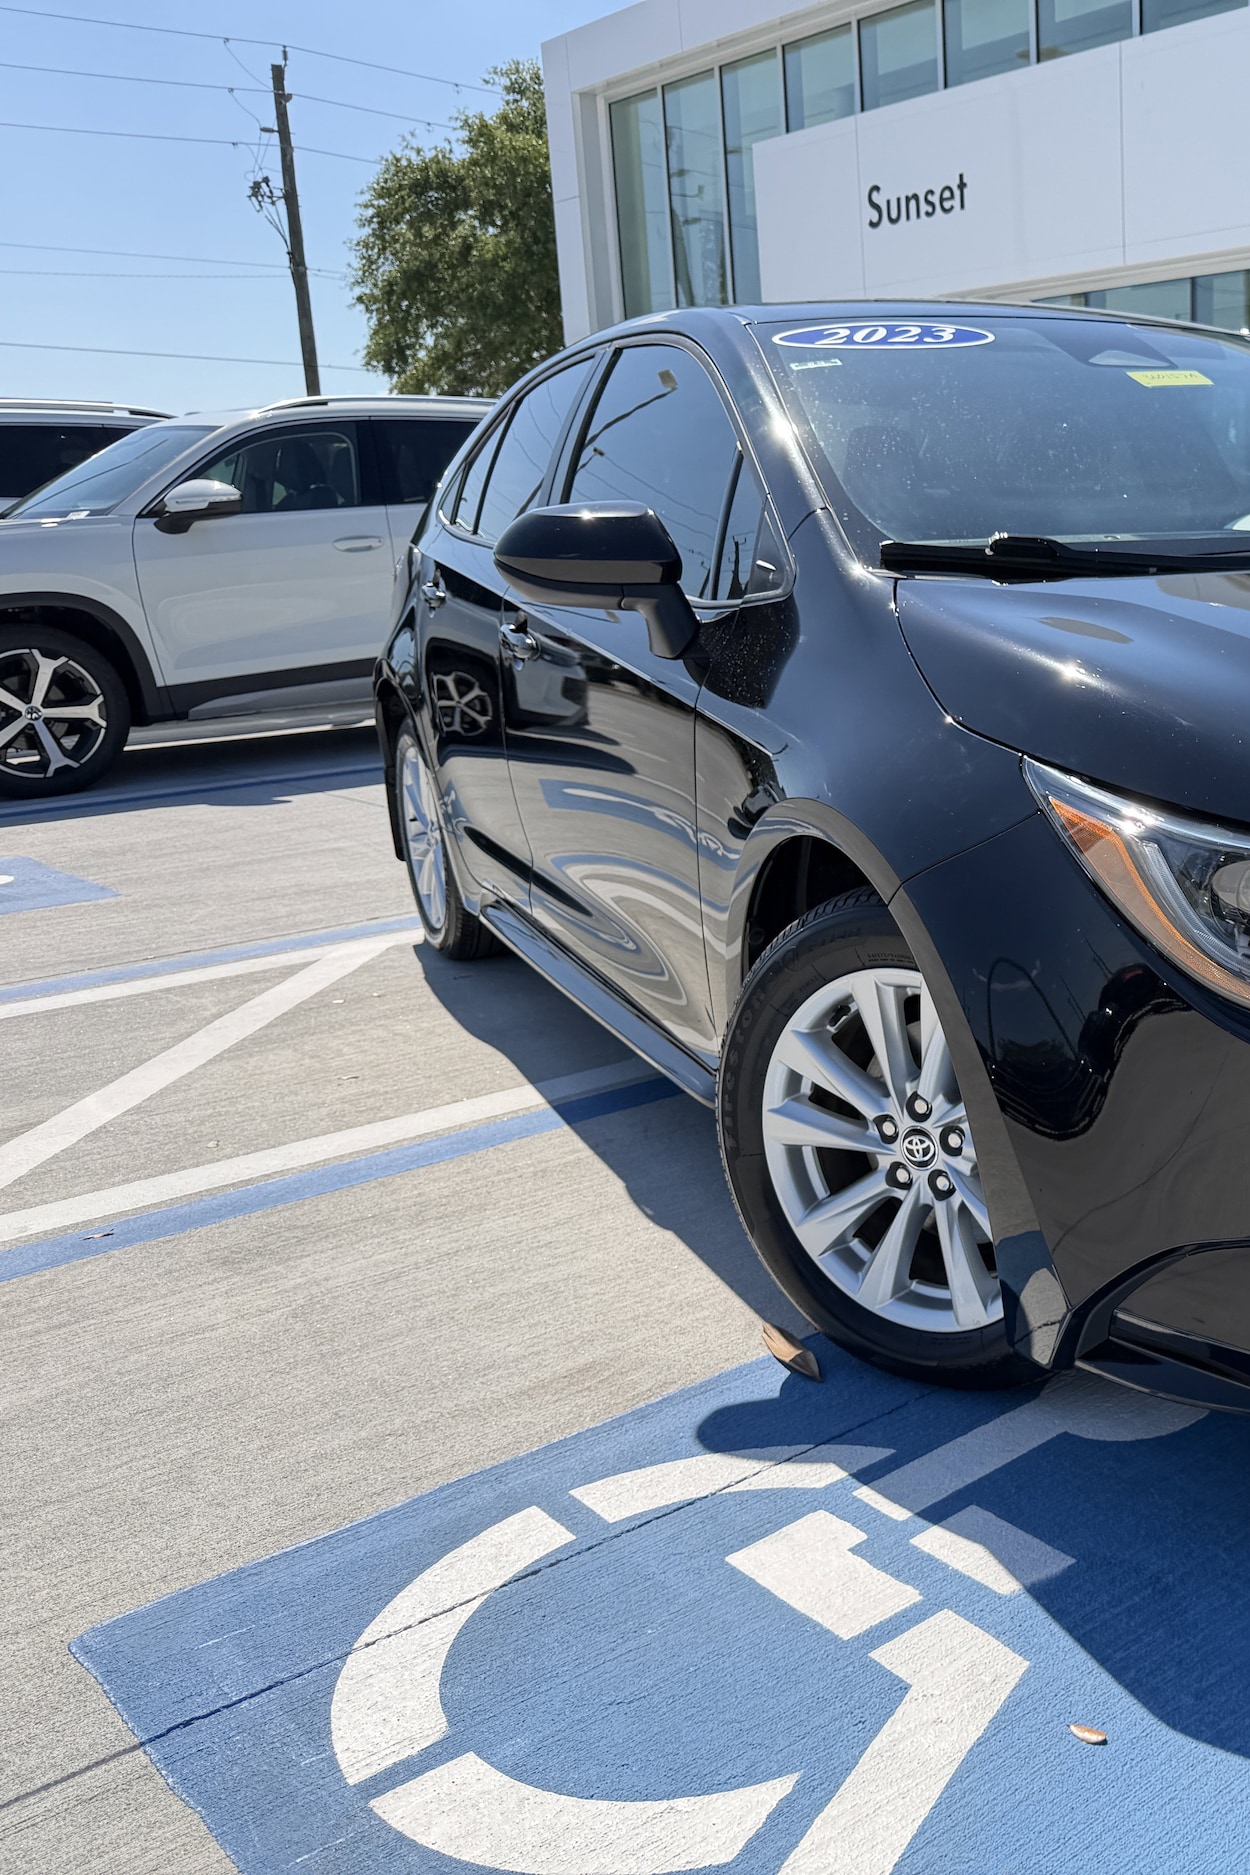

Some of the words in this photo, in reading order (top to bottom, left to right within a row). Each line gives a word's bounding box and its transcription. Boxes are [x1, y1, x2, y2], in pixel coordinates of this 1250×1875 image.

[867, 172, 967, 230] Sunset
[814, 326, 957, 345] 2023
[723, 975, 777, 1151] Fireston
